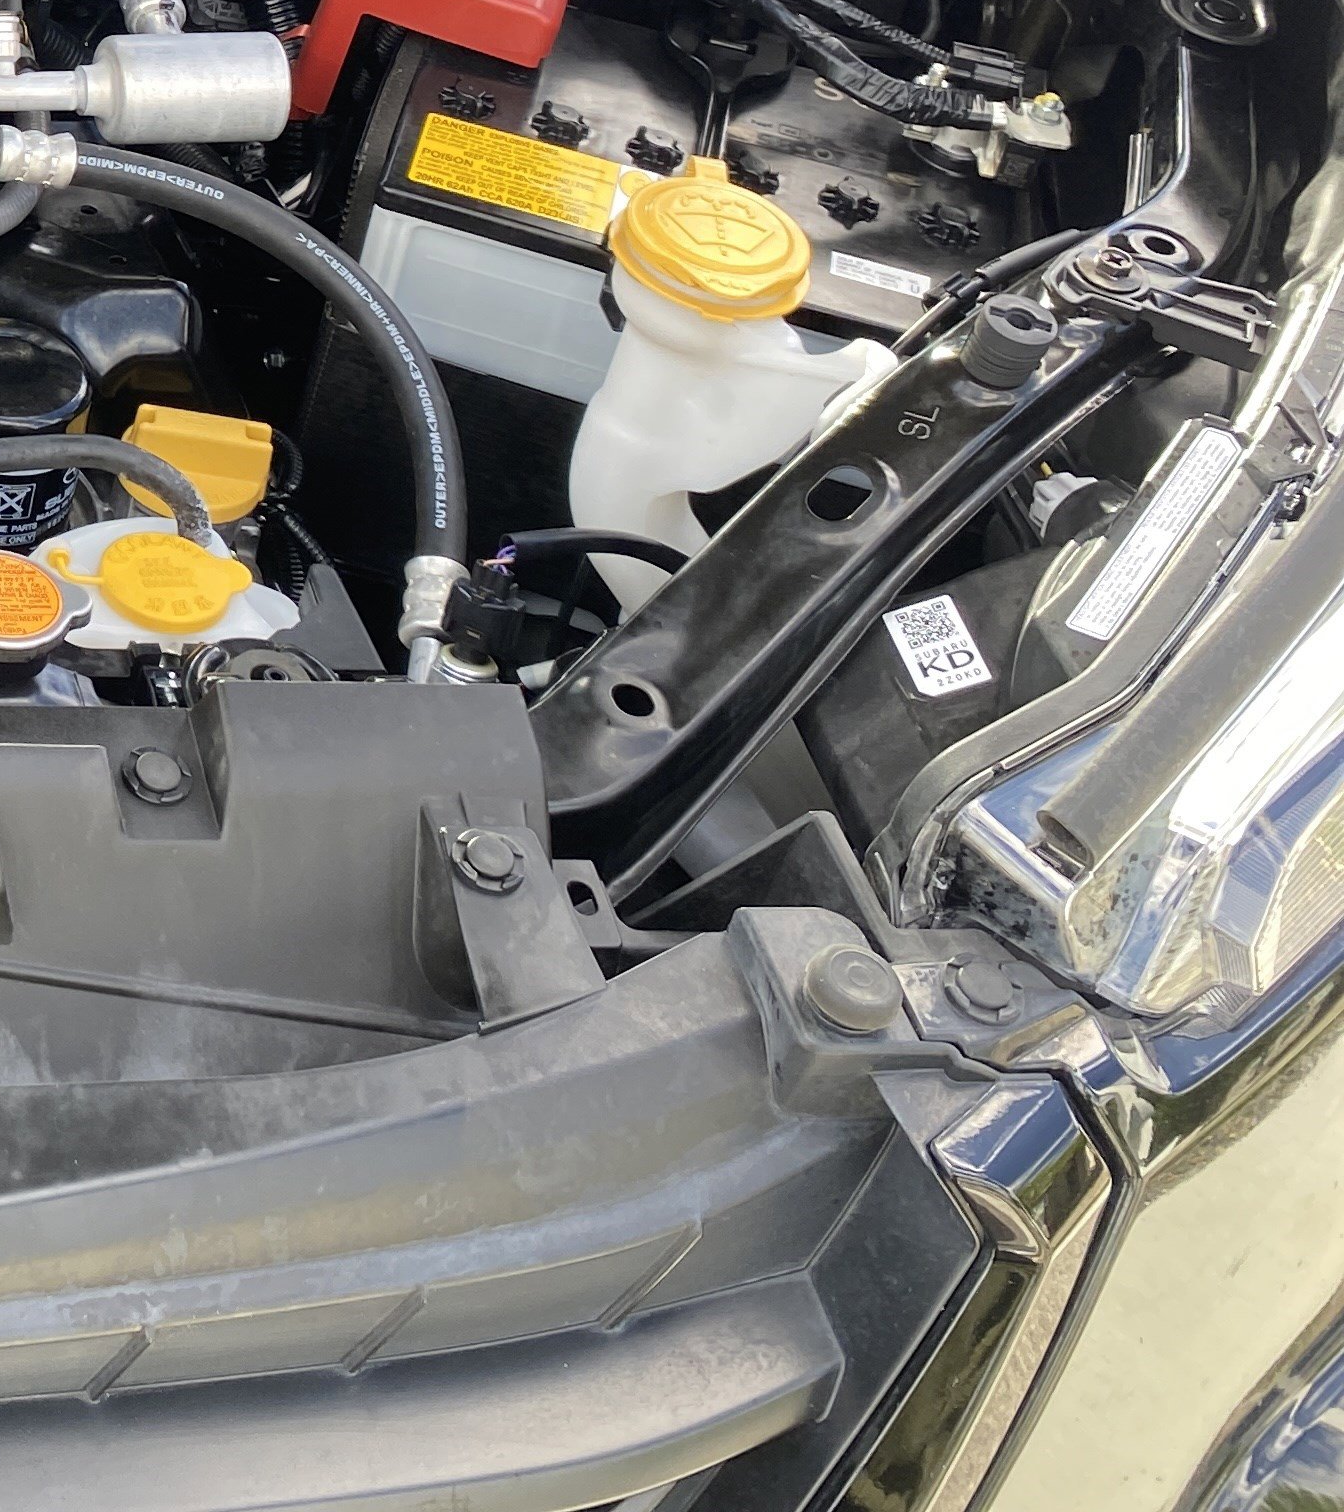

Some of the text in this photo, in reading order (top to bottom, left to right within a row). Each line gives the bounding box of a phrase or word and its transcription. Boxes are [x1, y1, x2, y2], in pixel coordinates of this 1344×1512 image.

[431, 116, 486, 137] DANGER
[422, 147, 474, 167] POISON
[447, 179, 474, 193] 62Ah
[479, 189, 503, 203] CCA
[898, 406, 940, 440] SL
[11, 522, 38, 533] PARTS
[914, 639, 969, 661] SUBARU
[917, 649, 974, 678] KD
